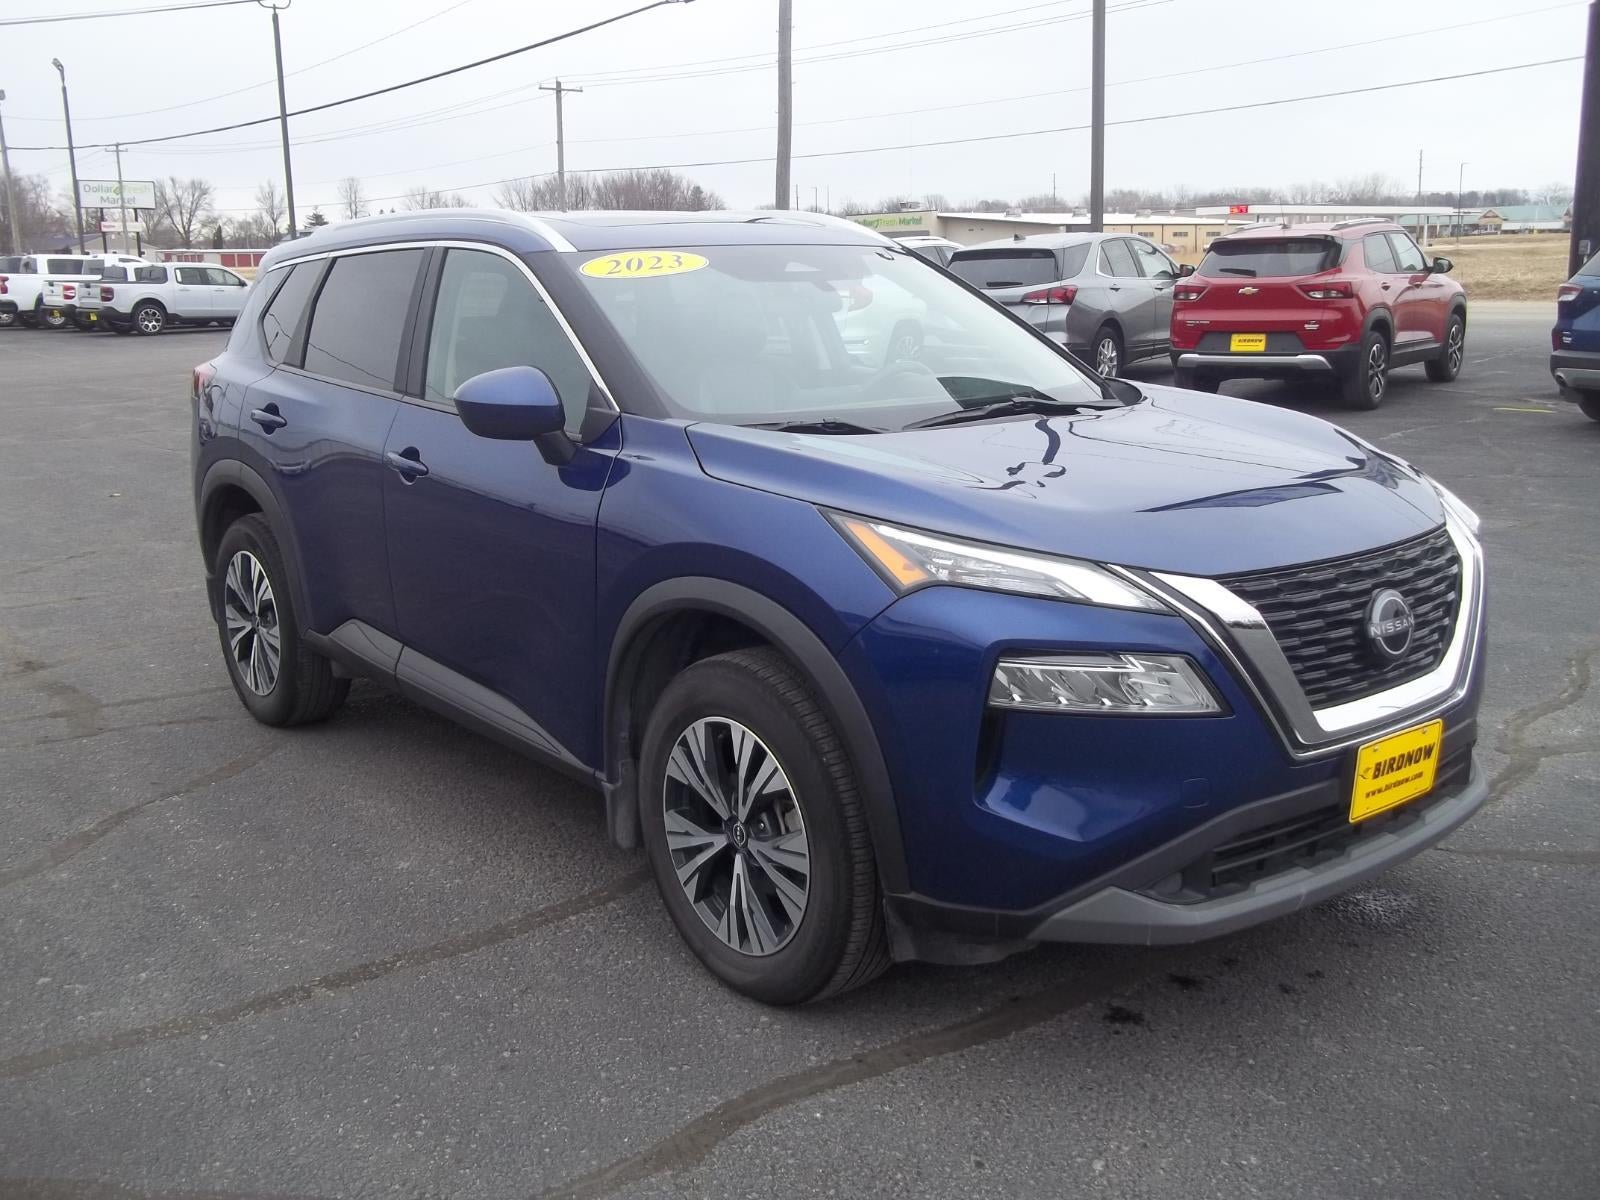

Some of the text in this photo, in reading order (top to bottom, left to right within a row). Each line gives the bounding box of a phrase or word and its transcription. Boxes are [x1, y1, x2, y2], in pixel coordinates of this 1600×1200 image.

[83, 183, 112, 193] Dollar
[606, 255, 683, 275] 2023
[1370, 615, 1415, 638] NISSAN
[1372, 742, 1436, 780] BIRDNOW
